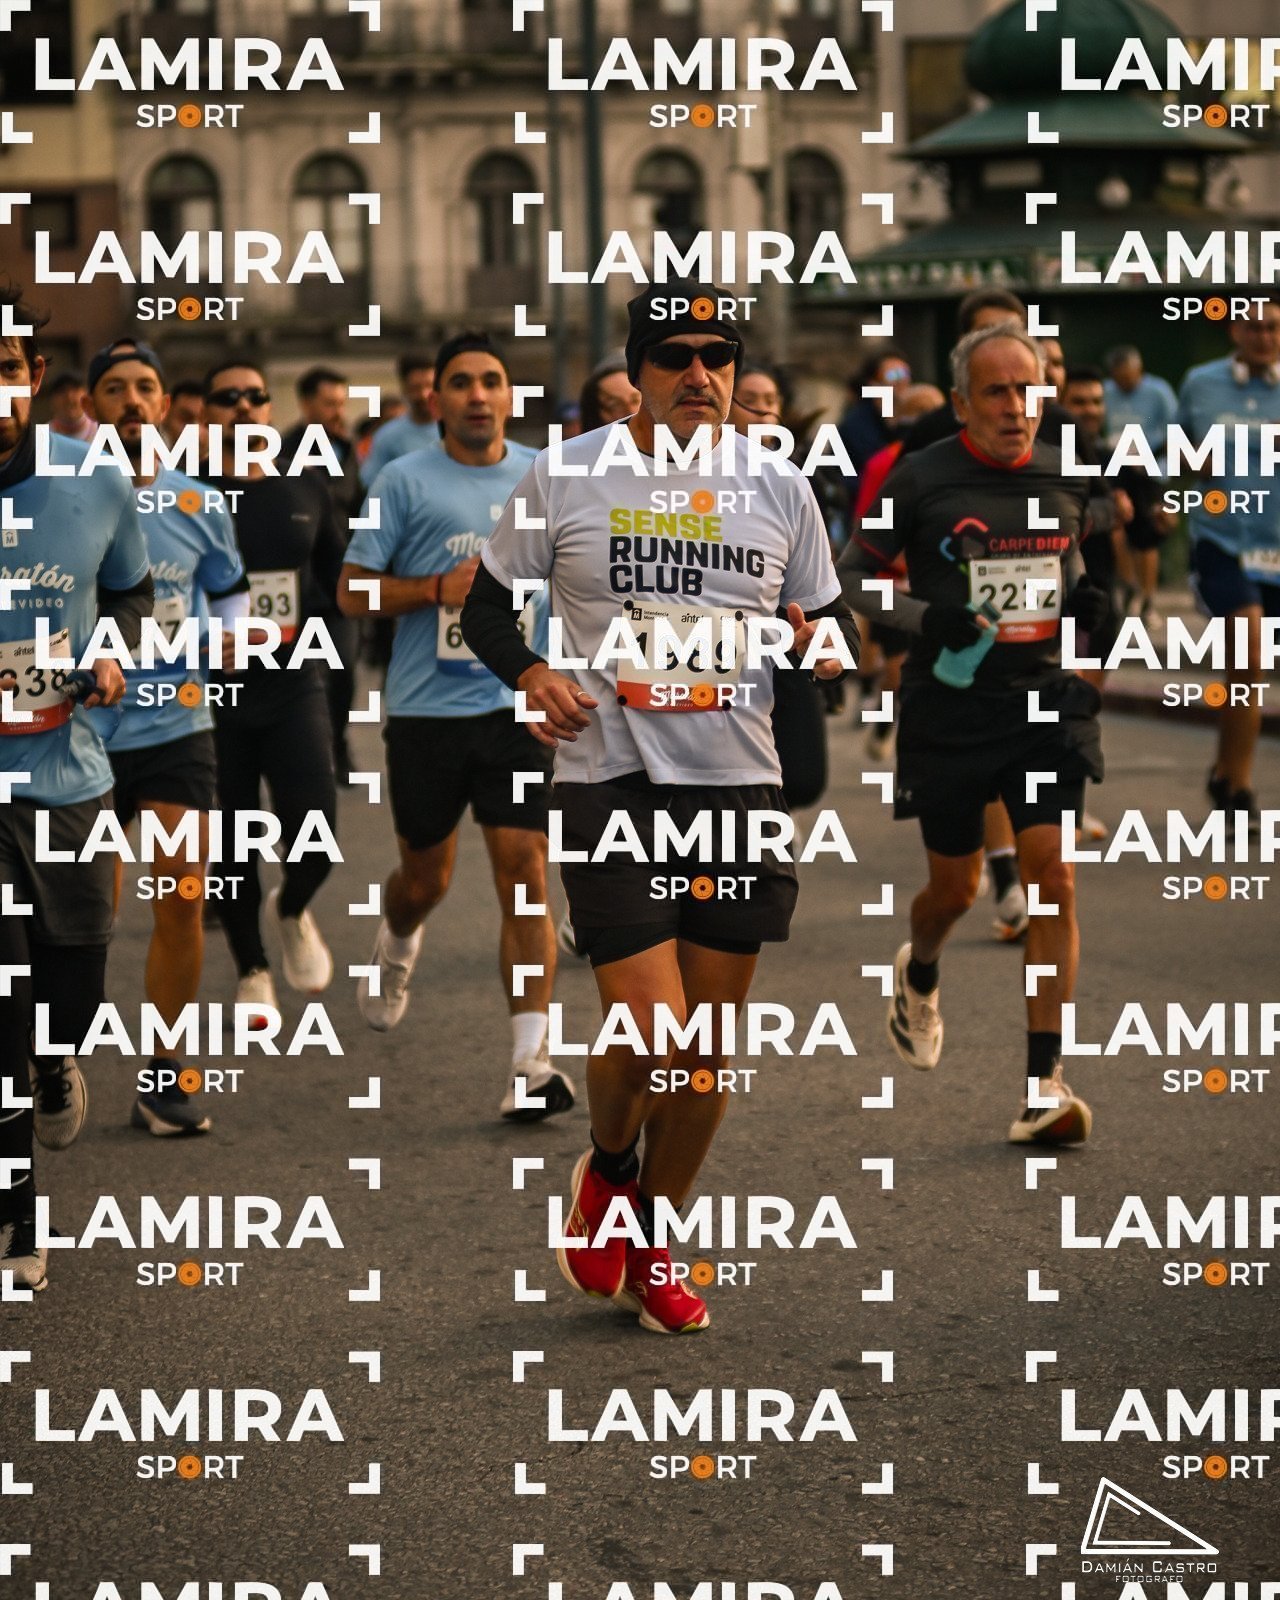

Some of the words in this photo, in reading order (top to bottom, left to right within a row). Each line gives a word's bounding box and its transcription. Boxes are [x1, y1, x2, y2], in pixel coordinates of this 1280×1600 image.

[610, 508, 723, 542] SENSE
[610, 536, 765, 578] RUNNING
[610, 565, 703, 596] CLUB
[250, 593, 291, 617] 93
[979, 583, 1056, 610] 222
